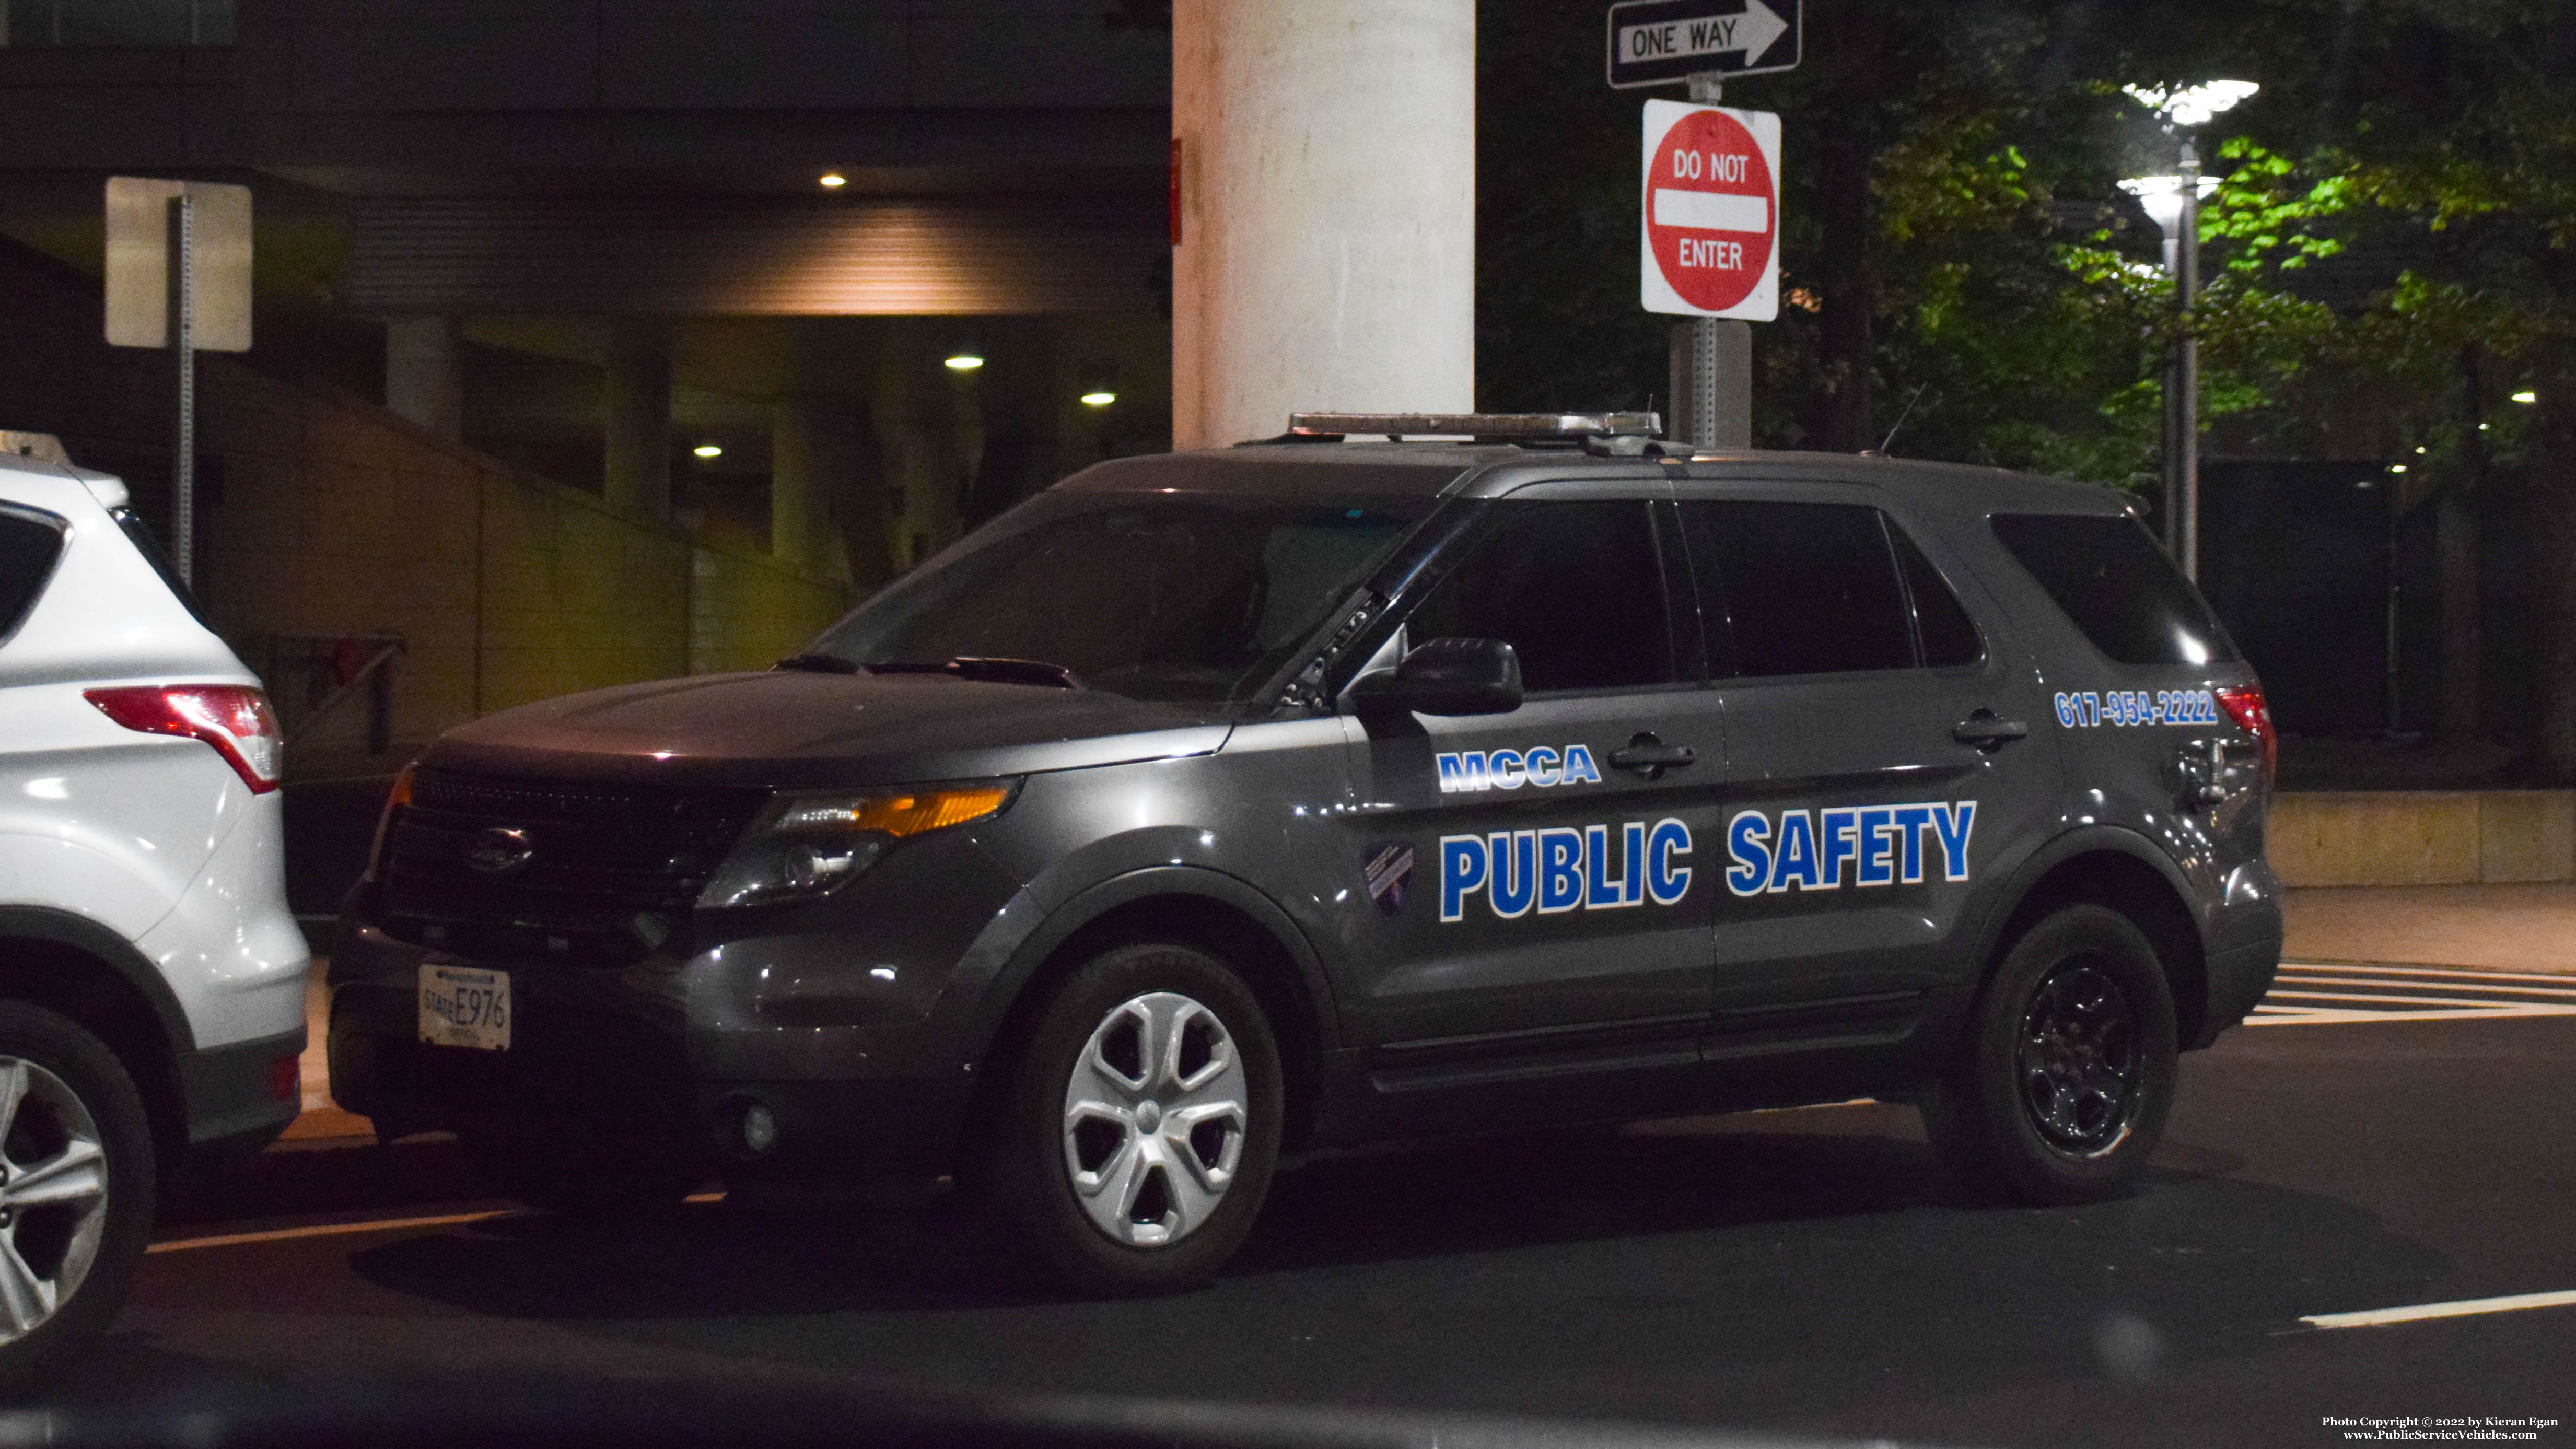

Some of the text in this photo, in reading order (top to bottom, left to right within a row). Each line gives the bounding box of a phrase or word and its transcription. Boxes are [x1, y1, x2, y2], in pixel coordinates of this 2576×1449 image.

[1633, 19, 1737, 56] ONE WAY
[1673, 149, 1749, 183] DO NOT
[1679, 238, 1742, 270] ENTER
[2054, 690, 2218, 728] 617-954-2222
[1436, 744, 1602, 792] MCCA
[1440, 817, 1692, 922] PUBLIC
[1726, 800, 1977, 896] SAFETY
[456, 987, 505, 1029] E976
